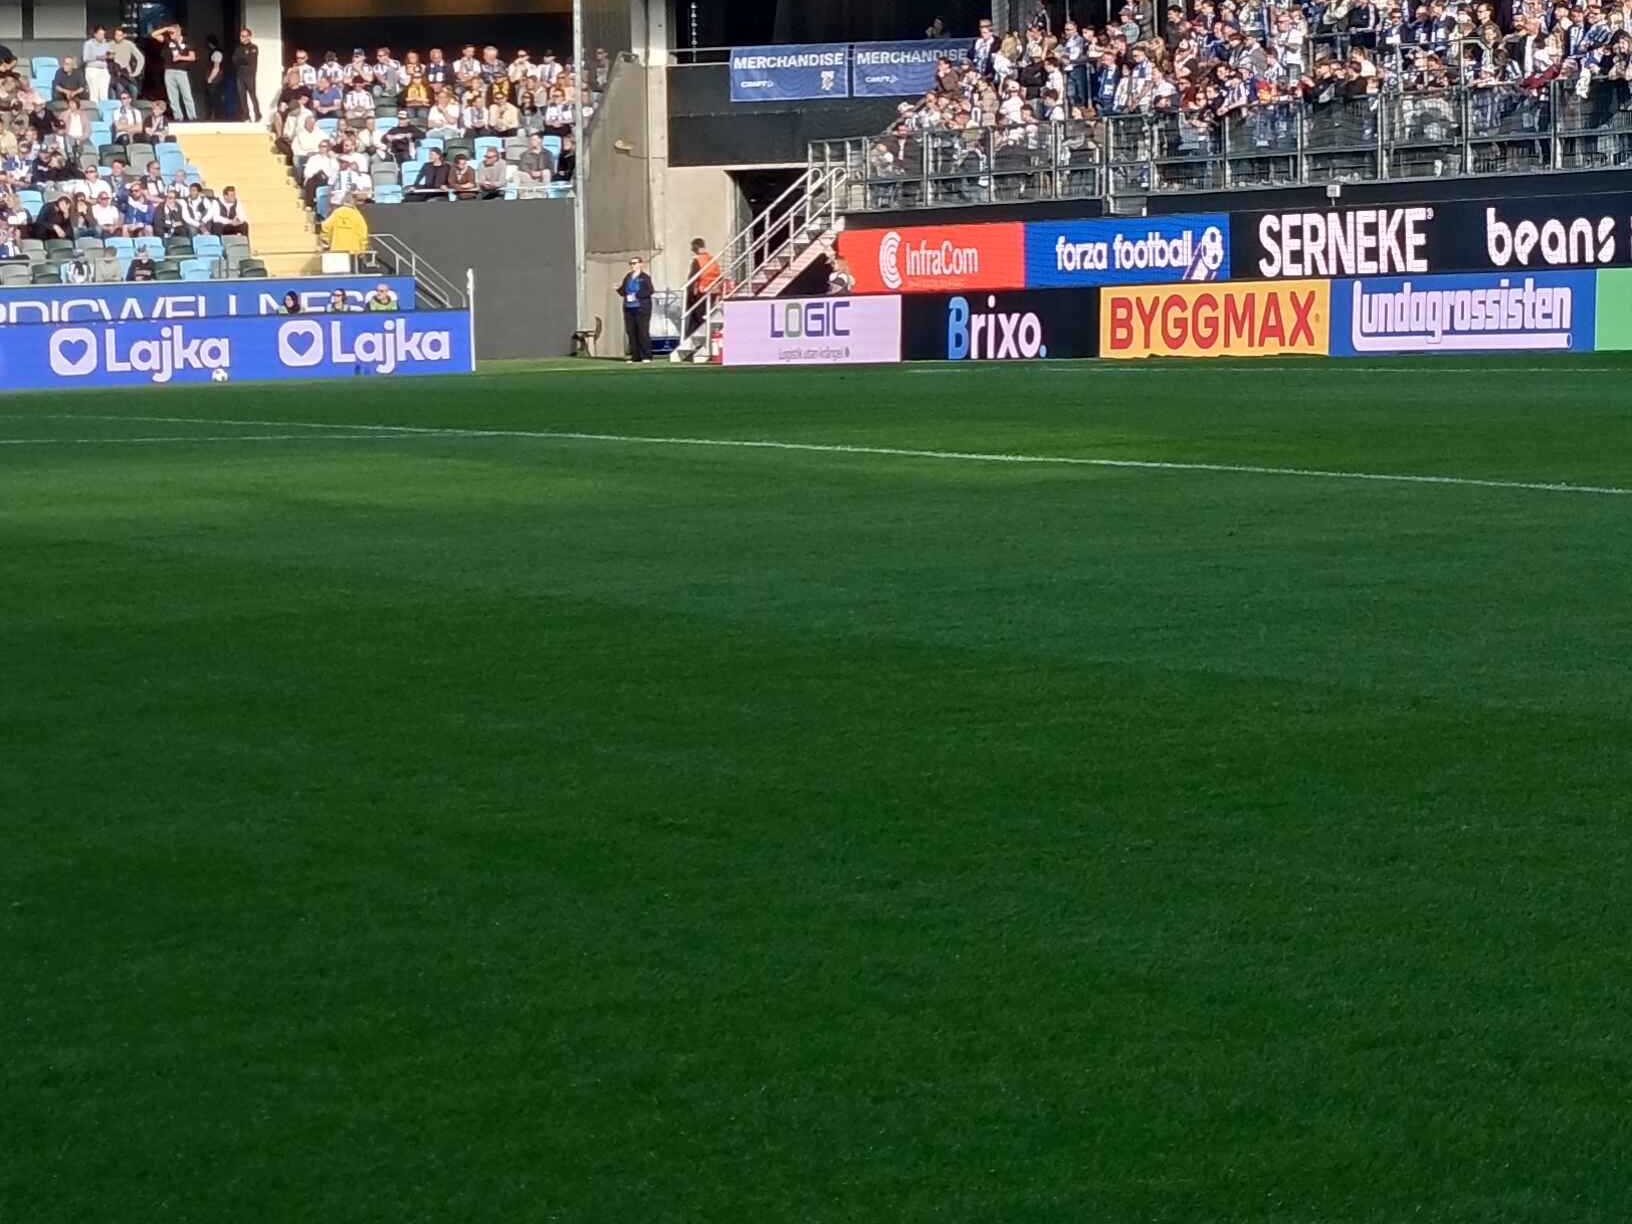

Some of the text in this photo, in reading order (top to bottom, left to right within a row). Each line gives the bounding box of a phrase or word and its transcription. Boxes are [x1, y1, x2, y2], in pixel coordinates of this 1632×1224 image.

[734, 52, 845, 70] MERCHANDISE
[906, 241, 978, 276] InfraCom
[1056, 230, 1194, 271] forza football
[1259, 208, 1428, 278] SERNEKE
[1486, 207, 1615, 266] beans
[332, 318, 450, 375] Lajka
[770, 301, 850, 338] LOGIC
[1110, 290, 1316, 350] BYGGMAX
[106, 324, 230, 383] Lajka
